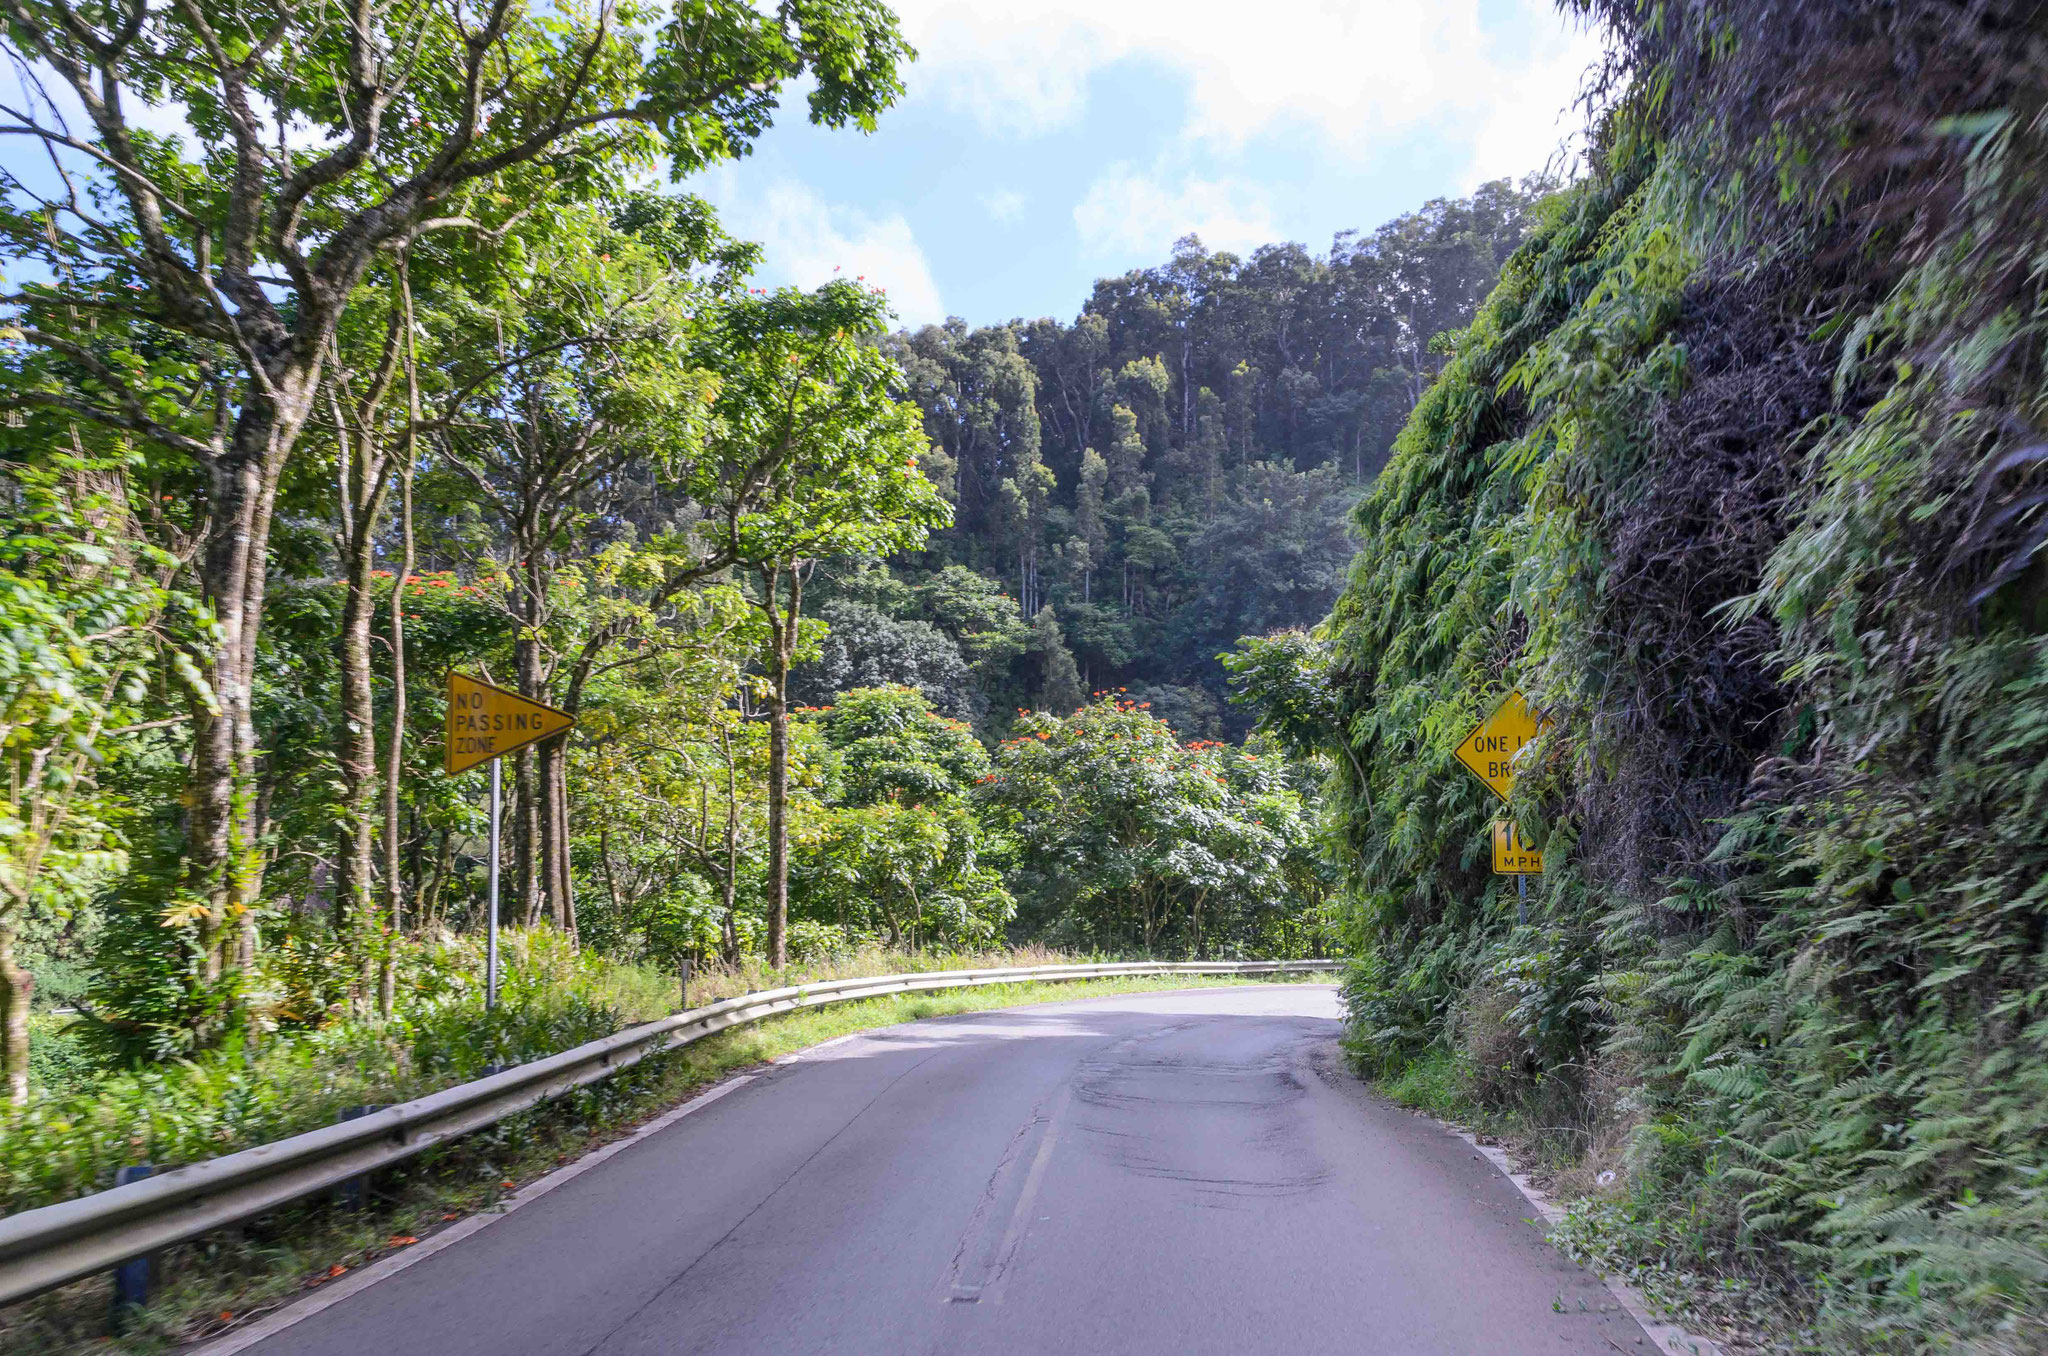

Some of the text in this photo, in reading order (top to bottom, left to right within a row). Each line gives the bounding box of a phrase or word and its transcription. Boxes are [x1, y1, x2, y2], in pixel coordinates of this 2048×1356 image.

[456, 692, 483, 710] NO
[455, 713, 543, 731] PASSING
[455, 736, 496, 754] ZONE
[1474, 736, 1508, 752] ONE
